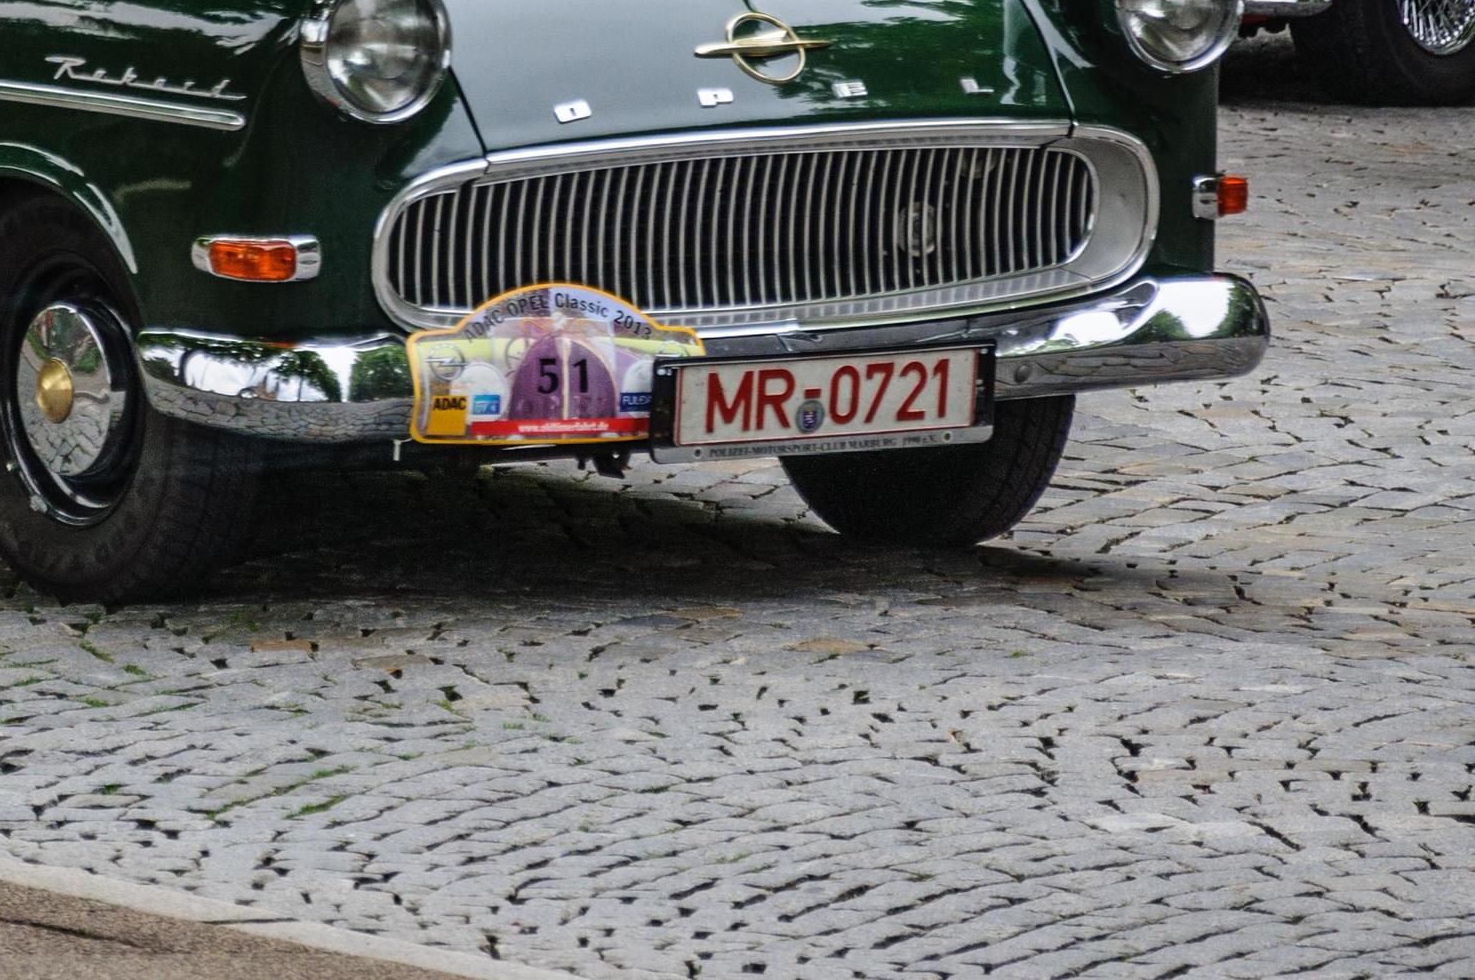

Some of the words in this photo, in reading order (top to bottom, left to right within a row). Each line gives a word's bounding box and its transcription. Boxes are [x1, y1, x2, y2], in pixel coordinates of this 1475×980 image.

[465, 309, 504, 342] ADAC
[507, 295, 548, 317] OPEL
[554, 292, 609, 318] Classic
[614, 310, 652, 340] 2013
[537, 358, 589, 394] 51
[432, 397, 467, 411] ADAC
[705, 358, 950, 433] MR-0721
[849, 438, 897, 451] MARBURG
